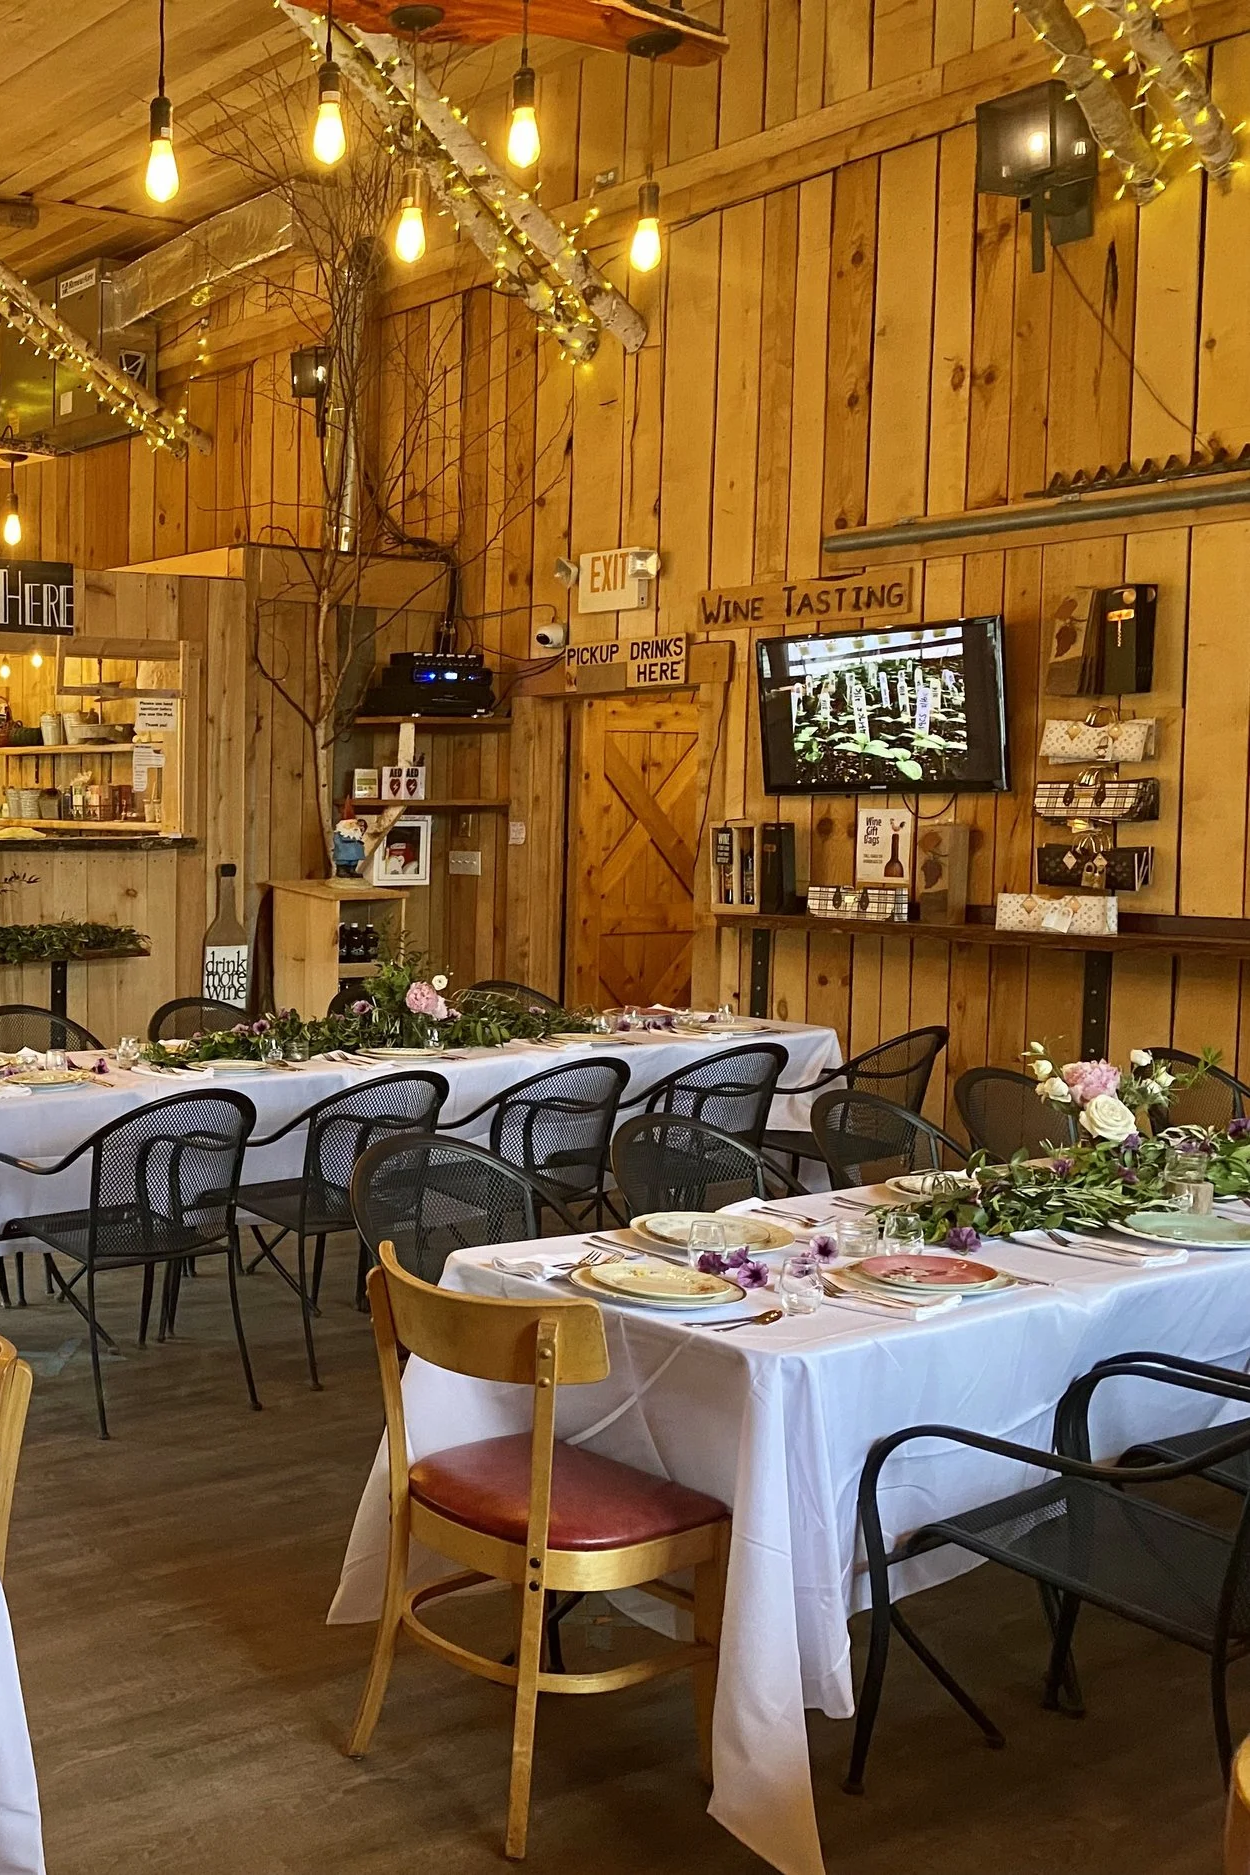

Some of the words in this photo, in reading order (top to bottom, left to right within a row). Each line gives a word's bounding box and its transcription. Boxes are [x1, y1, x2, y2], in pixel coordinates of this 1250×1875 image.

[590, 552, 630, 593] EXIT
[701, 594, 764, 625] WINE
[782, 583, 904, 617] TASTING
[566, 643, 620, 666] PICKUP
[630, 637, 684, 661] DRINKS
[637, 661, 681, 682] HERE
[389, 768, 403, 778] AED
[405, 768, 419, 778] AED
[866, 816, 882, 826] Wine
[866, 826, 878, 836] Gift
[863, 835, 880, 847] Bags
[205, 950, 248, 973] drink
[205, 971, 247, 988] more
[205, 984, 247, 1001] wine
